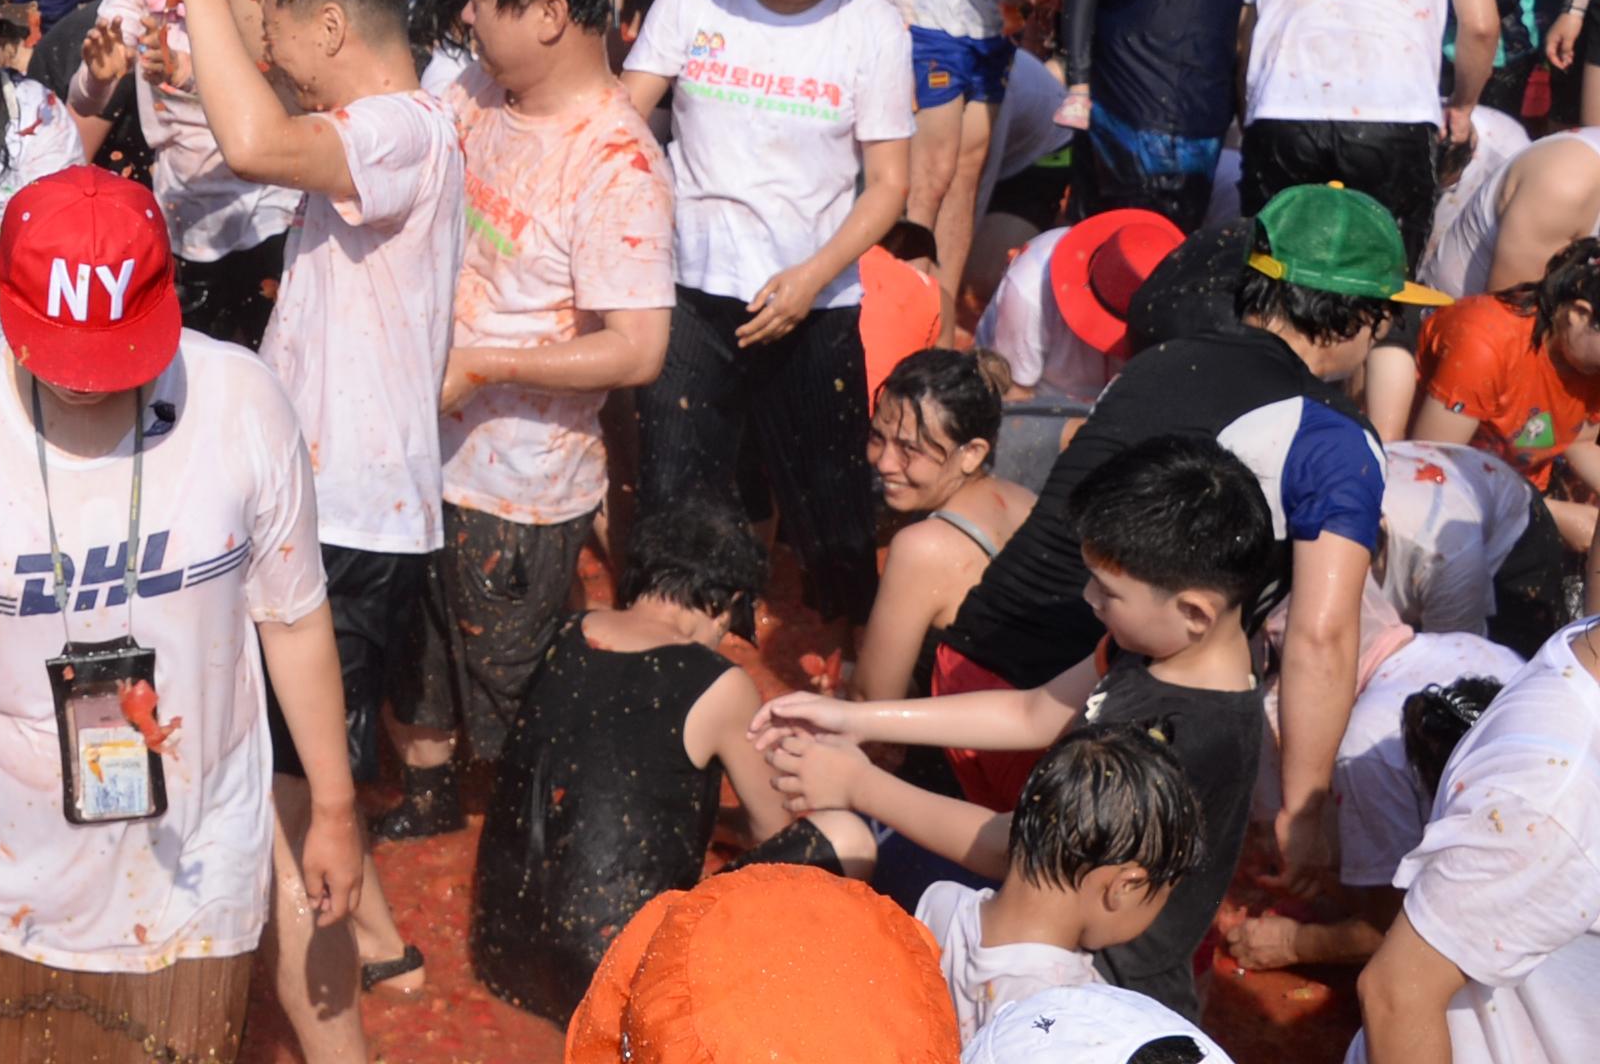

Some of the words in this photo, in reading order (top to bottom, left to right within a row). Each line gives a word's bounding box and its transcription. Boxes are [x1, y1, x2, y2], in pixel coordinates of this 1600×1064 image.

[686, 59, 842, 108] 화천토마토축제
[47, 257, 135, 322] NY
[14, 530, 184, 617] DHL
